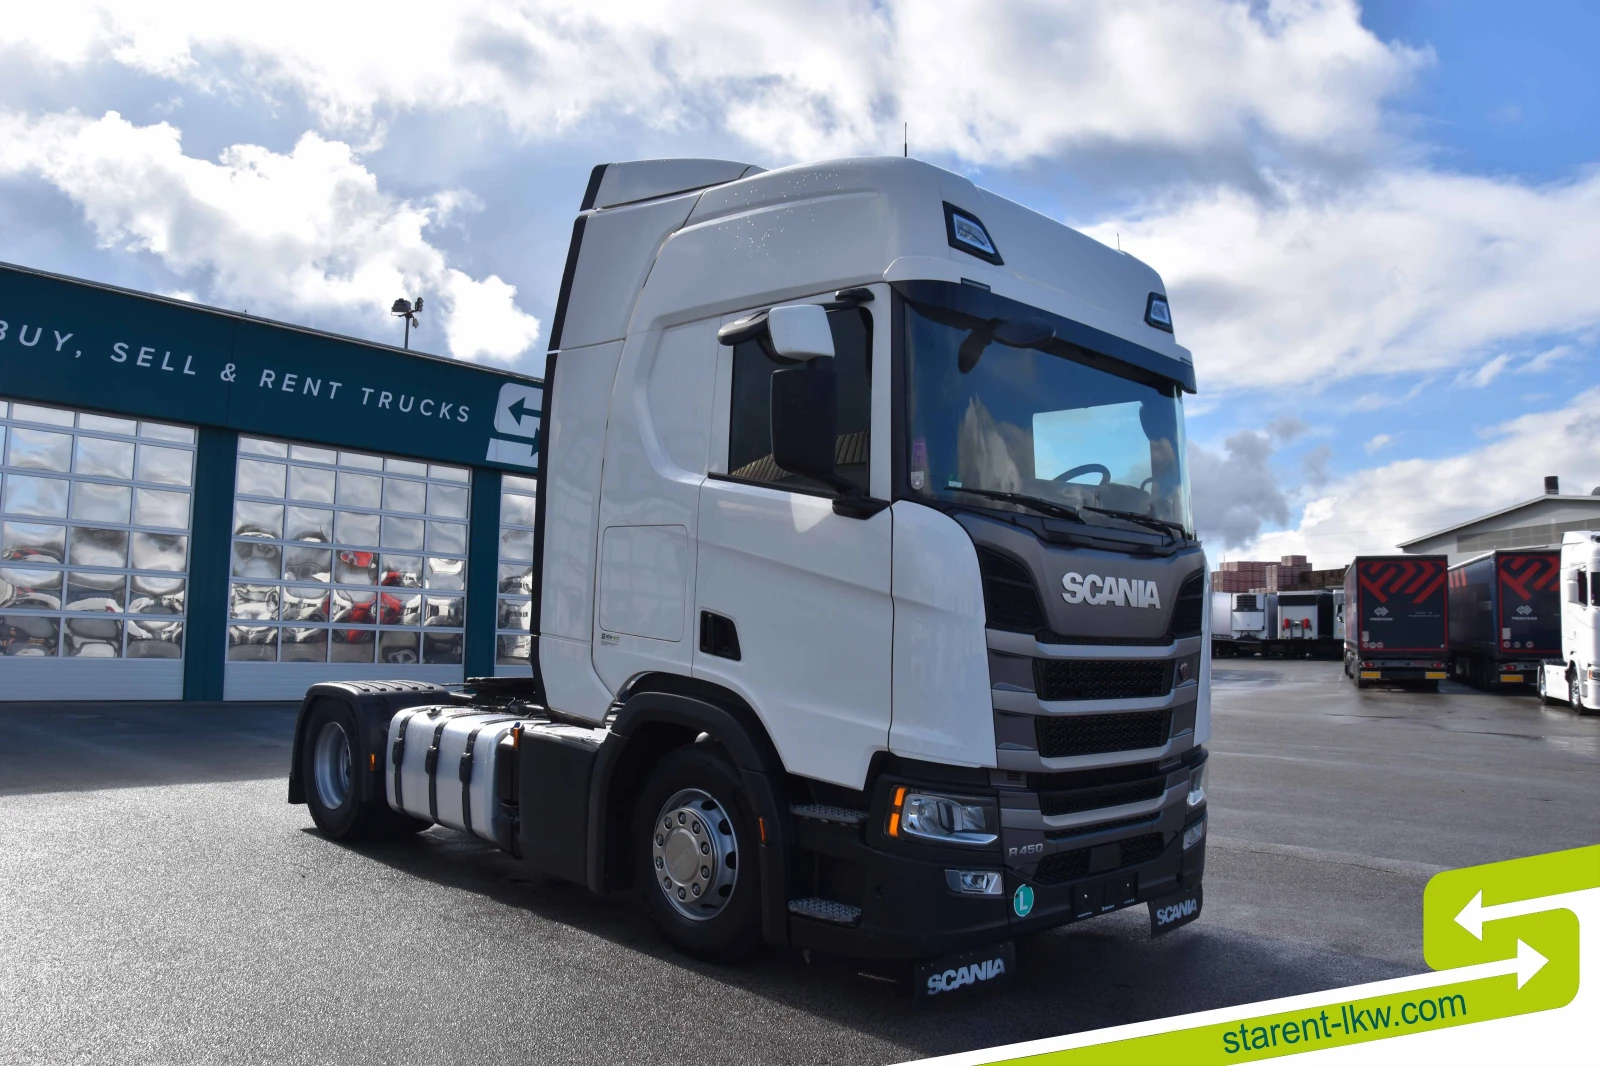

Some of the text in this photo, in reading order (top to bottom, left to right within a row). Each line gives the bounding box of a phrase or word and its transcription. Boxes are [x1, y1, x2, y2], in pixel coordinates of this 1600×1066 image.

[110, 342, 196, 376] SELL
[220, 362, 237, 383] &
[259, 369, 342, 400] RENT
[361, 387, 470, 423] TRUCKS
[1061, 572, 1161, 609] SCANIA
[1008, 843, 1044, 858] R 450
[1019, 890, 1028, 911] L
[1156, 898, 1197, 926] SCANIA
[927, 957, 1005, 995] SCANIA
